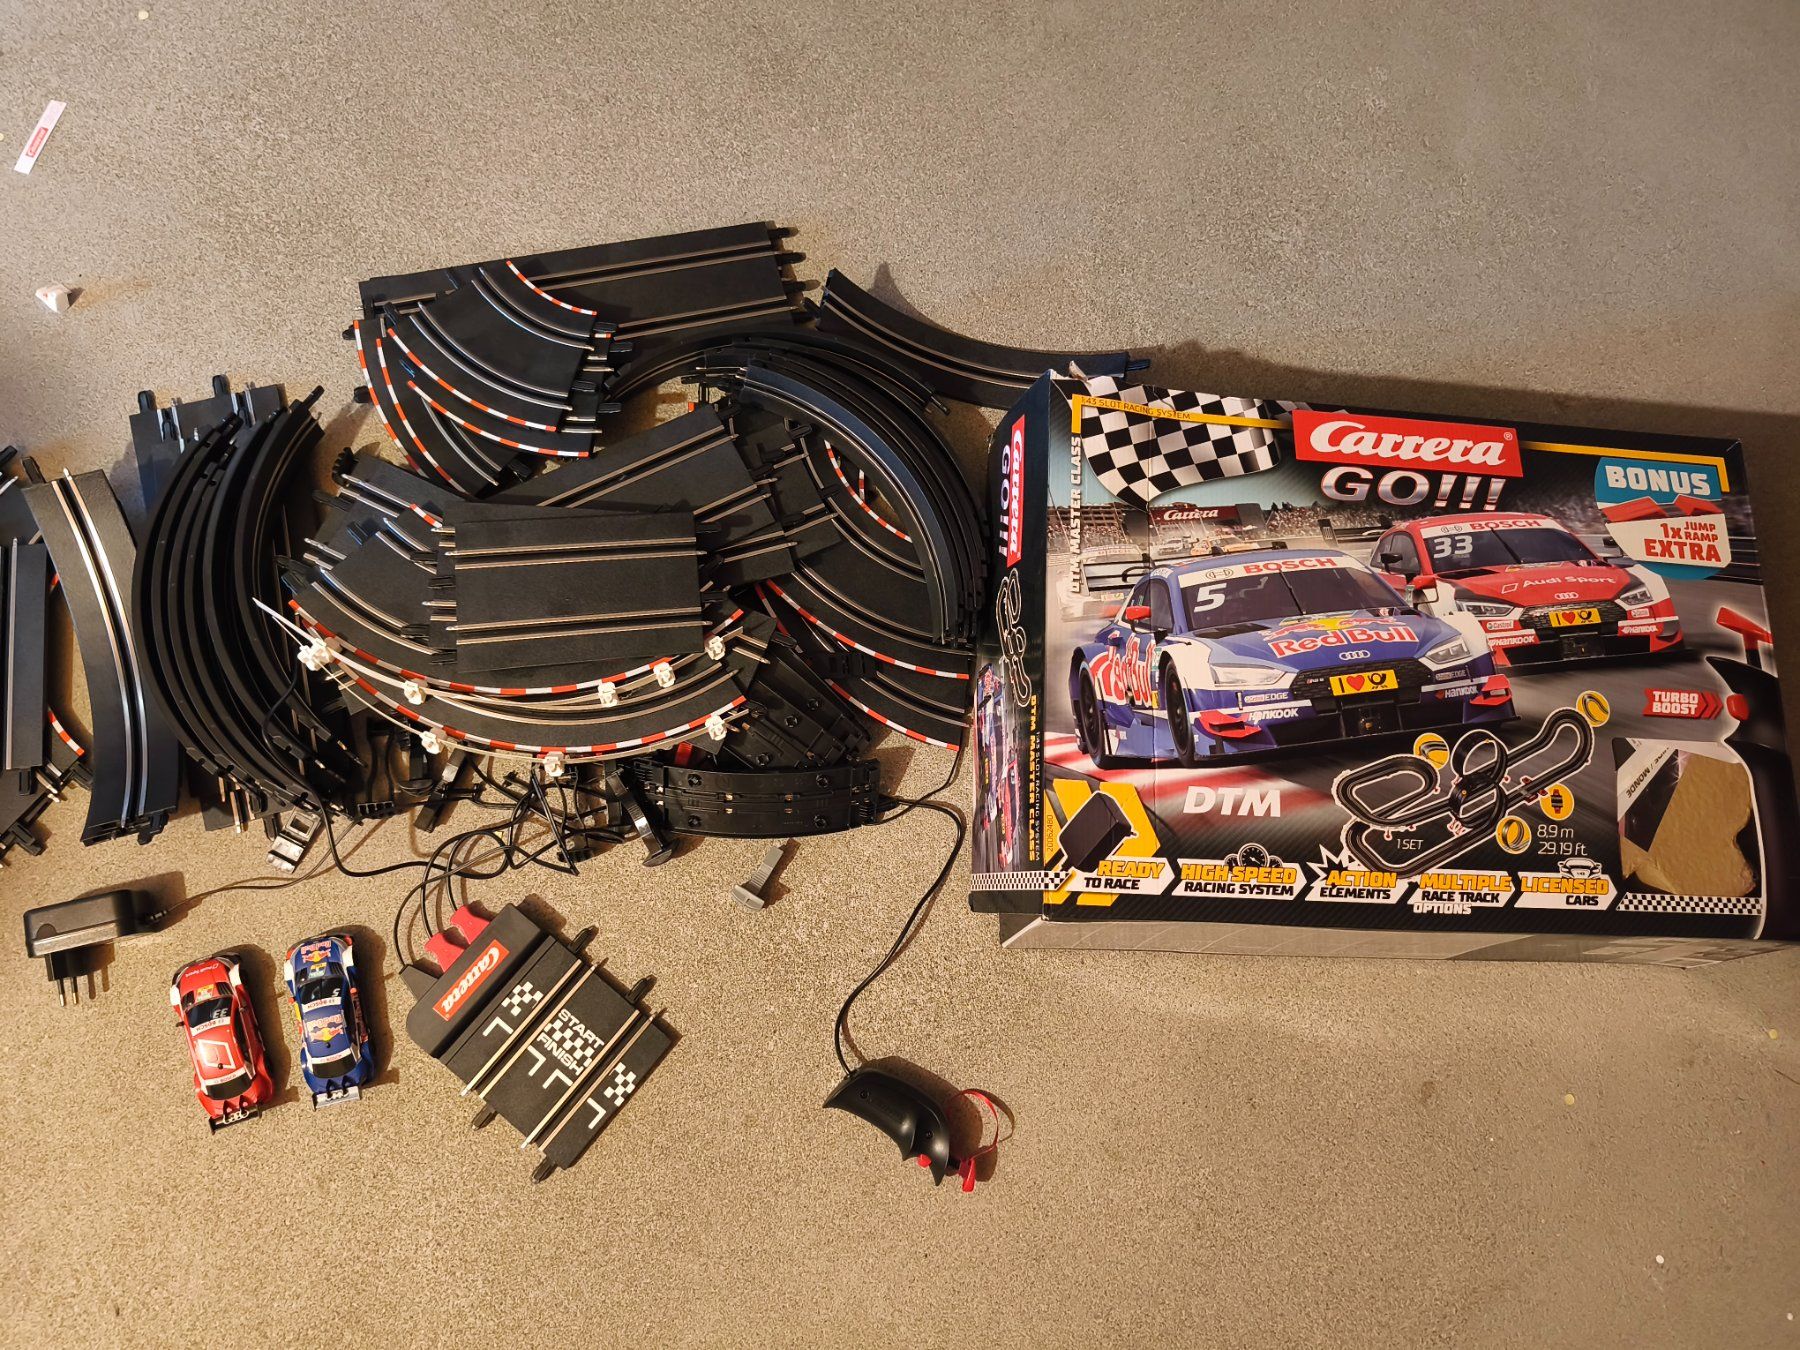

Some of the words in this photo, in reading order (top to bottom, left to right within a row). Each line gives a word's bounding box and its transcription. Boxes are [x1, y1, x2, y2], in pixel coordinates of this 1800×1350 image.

[1100, 399, 1122, 408] SLOT
[1124, 404, 1154, 415] RACING
[1156, 408, 1191, 420] SYSTEM
[1310, 420, 1506, 466] Carrera
[1071, 436, 1081, 484] CLASS
[1320, 466, 1507, 511] GO!!!
[1605, 466, 1710, 496] BONUS
[999, 444, 1010, 558] GO!!!
[1010, 429, 1022, 555] Carrera
[1070, 490, 1081, 554] MASTER
[1164, 509, 1218, 520] Carrera
[1470, 520, 1542, 530] BOSCH
[1660, 522, 1682, 540] 1x
[1684, 521, 1716, 532] JUMP
[1684, 532, 1718, 542] RAMP
[1434, 535, 1473, 558] 33
[1644, 538, 1721, 562] EXTRA
[1244, 558, 1338, 574] BOSCH
[1071, 560, 1081, 592] DTM
[1523, 577, 1562, 588] Audi
[1564, 576, 1616, 584] Sport
[1194, 582, 1228, 613] 5
[1268, 630, 1347, 658] Red
[1342, 626, 1419, 643] Bull
[1338, 678, 1345, 693] I
[1265, 692, 1288, 700] EDGE
[1652, 691, 1698, 704] TURBO
[1652, 702, 1698, 714] BOOST
[1626, 766, 1651, 798] MONDE
[1183, 786, 1280, 818] DTM
[1560, 827, 1574, 838] m
[1402, 839, 1424, 850] SET
[1538, 842, 1573, 855] 29.19
[1574, 842, 1588, 856] ft
[1097, 860, 1165, 879] READY
[1181, 864, 1231, 882] HIGH
[1232, 866, 1297, 884] SPEED
[1084, 877, 1101, 888] TO
[1104, 878, 1140, 890] RACE
[1326, 870, 1398, 888] ACTION
[1419, 873, 1512, 892] MULTIPLE
[1521, 876, 1609, 896] LICENSED
[1184, 882, 1236, 894] RACING
[1239, 884, 1294, 896] SYSTEM
[1320, 888, 1391, 900] ELEMENTS
[1422, 890, 1454, 902] RACE
[1458, 892, 1500, 904] TRACK
[1413, 902, 1472, 915] OPTIONS
[1566, 895, 1599, 906] CARS
[442, 947, 500, 1012] Carrera
[332, 988, 341, 997] 5
[213, 1008, 228, 1019] 33
[558, 1008, 604, 1048] START
[536, 1032, 584, 1076] FINISH
